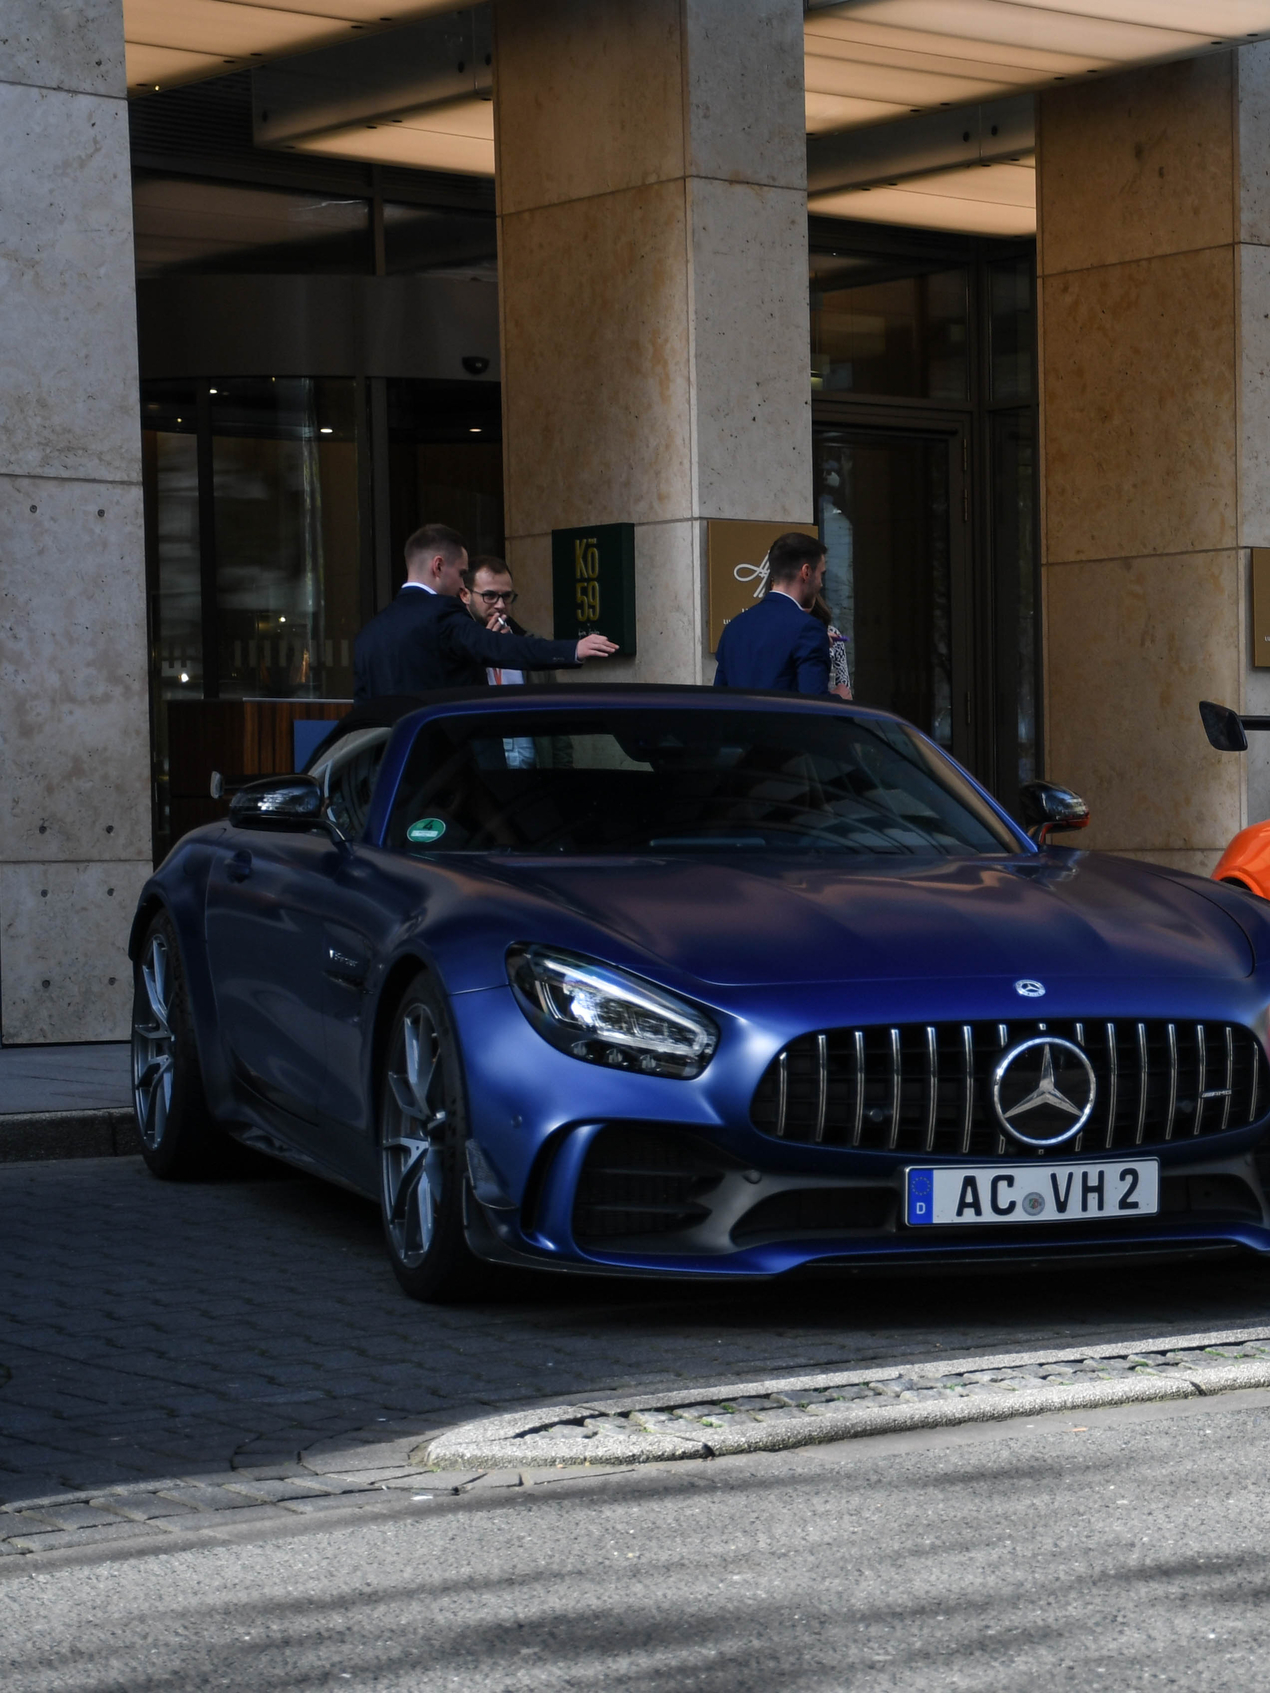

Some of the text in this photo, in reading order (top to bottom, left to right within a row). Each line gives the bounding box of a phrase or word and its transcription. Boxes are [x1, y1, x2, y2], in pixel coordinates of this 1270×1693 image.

[576, 581, 600, 622] 59
[916, 1202, 925, 1214] D
[956, 1174, 1016, 1216] AC
